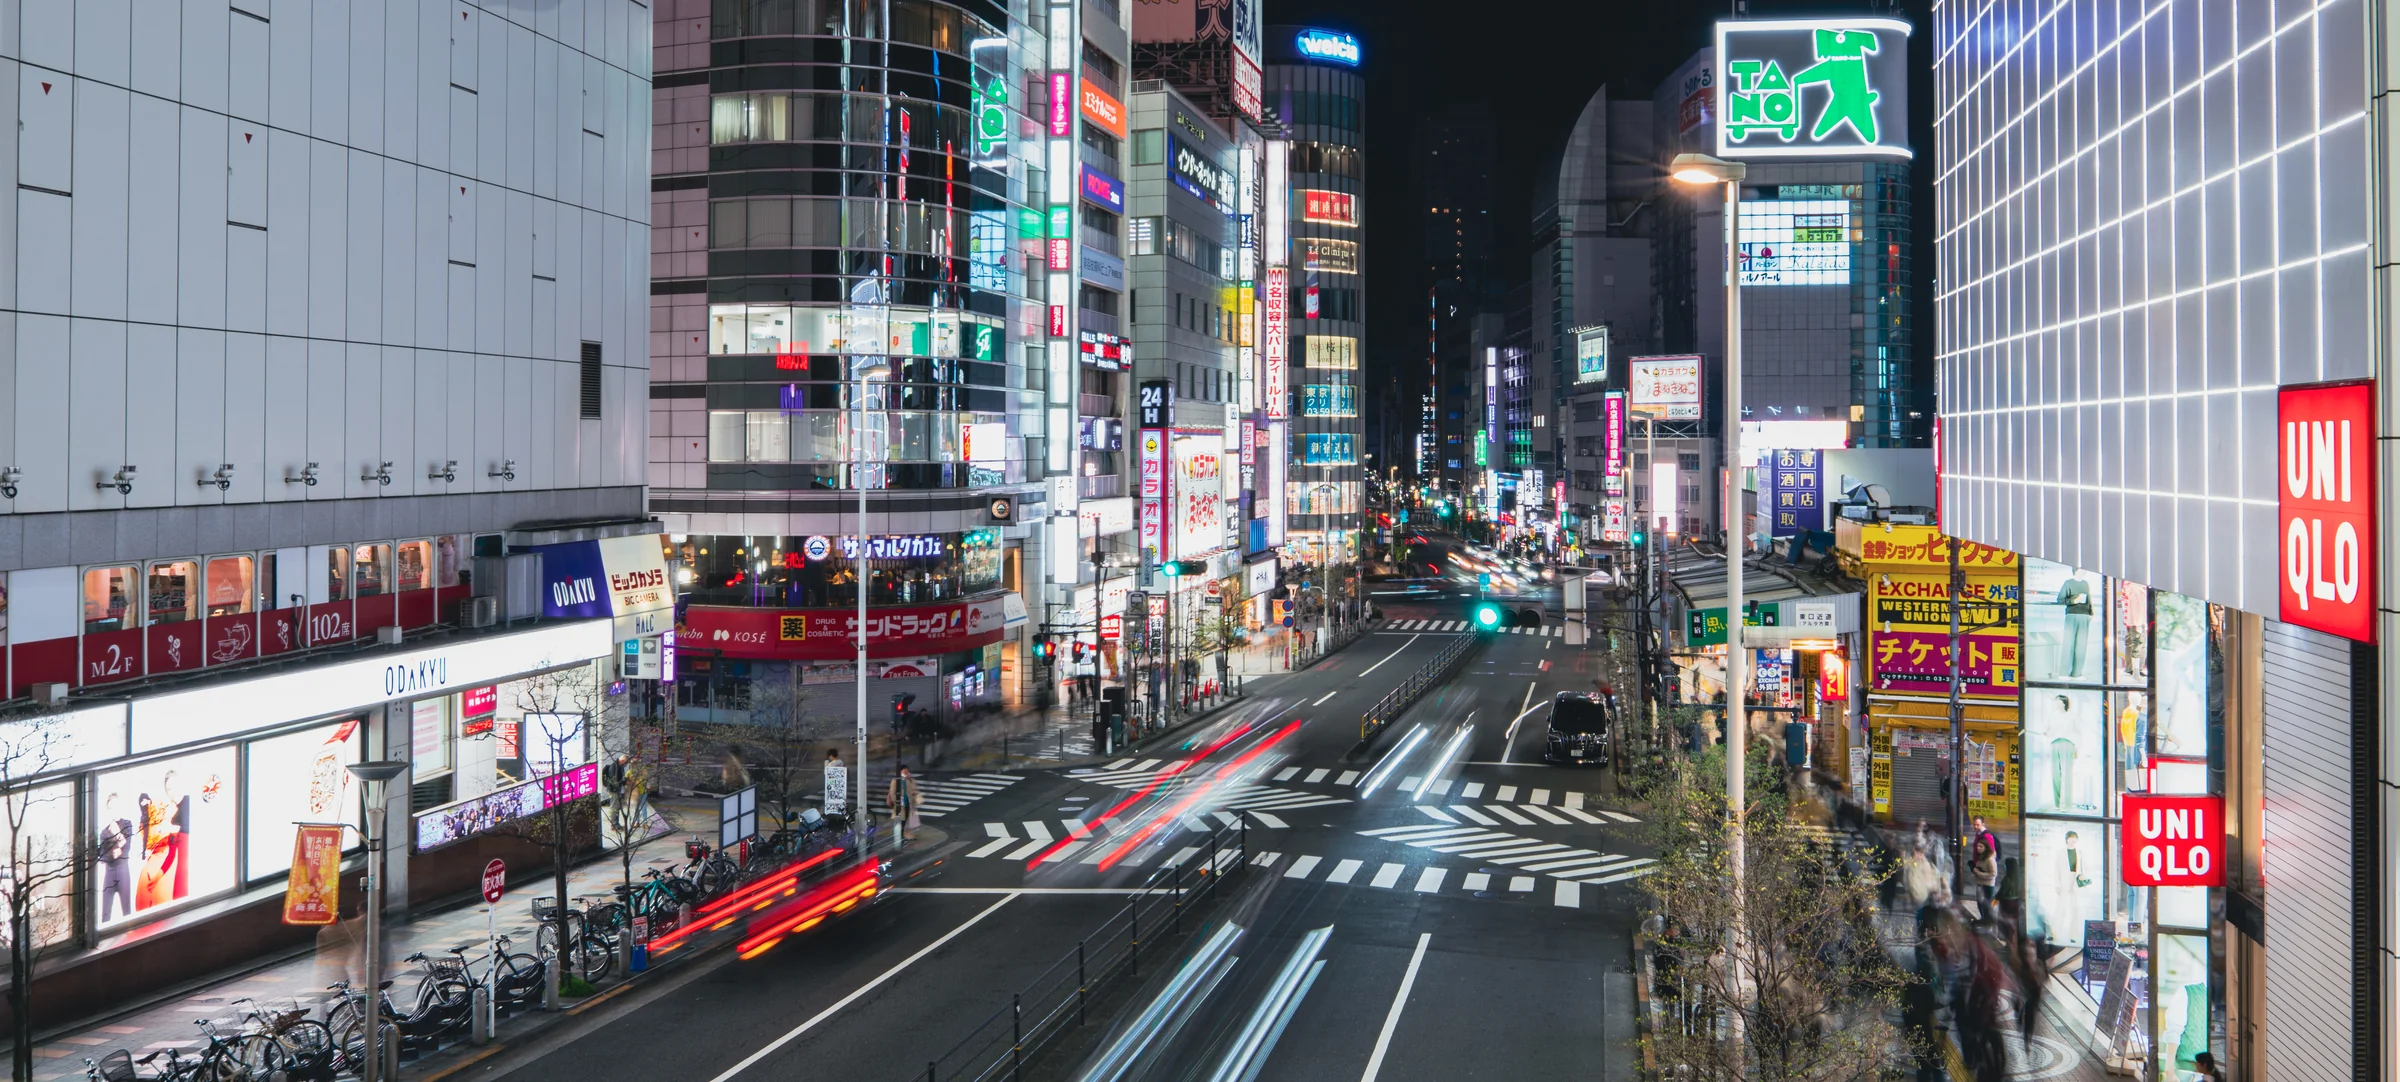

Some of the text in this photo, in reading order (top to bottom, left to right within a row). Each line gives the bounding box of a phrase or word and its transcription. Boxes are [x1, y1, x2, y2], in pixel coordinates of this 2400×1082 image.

[1304, 36, 1358, 62] welcia
[1731, 61, 1790, 90] TA
[1732, 92, 1792, 122] NO
[1267, 269, 1282, 417] 100名収容大パーティールーム
[1660, 367, 1688, 376] カラオケ
[1141, 387, 1162, 407] 24
[1653, 382, 1696, 396] まねきねこ
[1145, 410, 1158, 423] H
[1243, 424, 1252, 461] カラオケ
[2287, 419, 2351, 502] UNI
[1781, 454, 1795, 525] お酒買取
[1801, 453, 1814, 506] 専門店
[1144, 459, 1159, 537] カラオケ
[2287, 517, 2359, 611] QLO
[553, 577, 596, 607] ODAKYU
[611, 568, 664, 592] ビックカメラ
[624, 594, 635, 606] BIC
[311, 612, 351, 642] 102席
[734, 631, 767, 643] KOSÉ
[782, 617, 804, 639] 薬
[807, 630, 844, 638] COSMETIC
[1877, 638, 1988, 668] チケット
[2002, 647, 2015, 660] 販
[385, 657, 447, 696] ODAKYU
[888, 670, 919, 679] Tax Free
[1877, 665, 1936, 673] TICKET
[2002, 669, 2015, 683] 買
[2139, 808, 2204, 839] UNI
[2139, 845, 2210, 881] QLO
